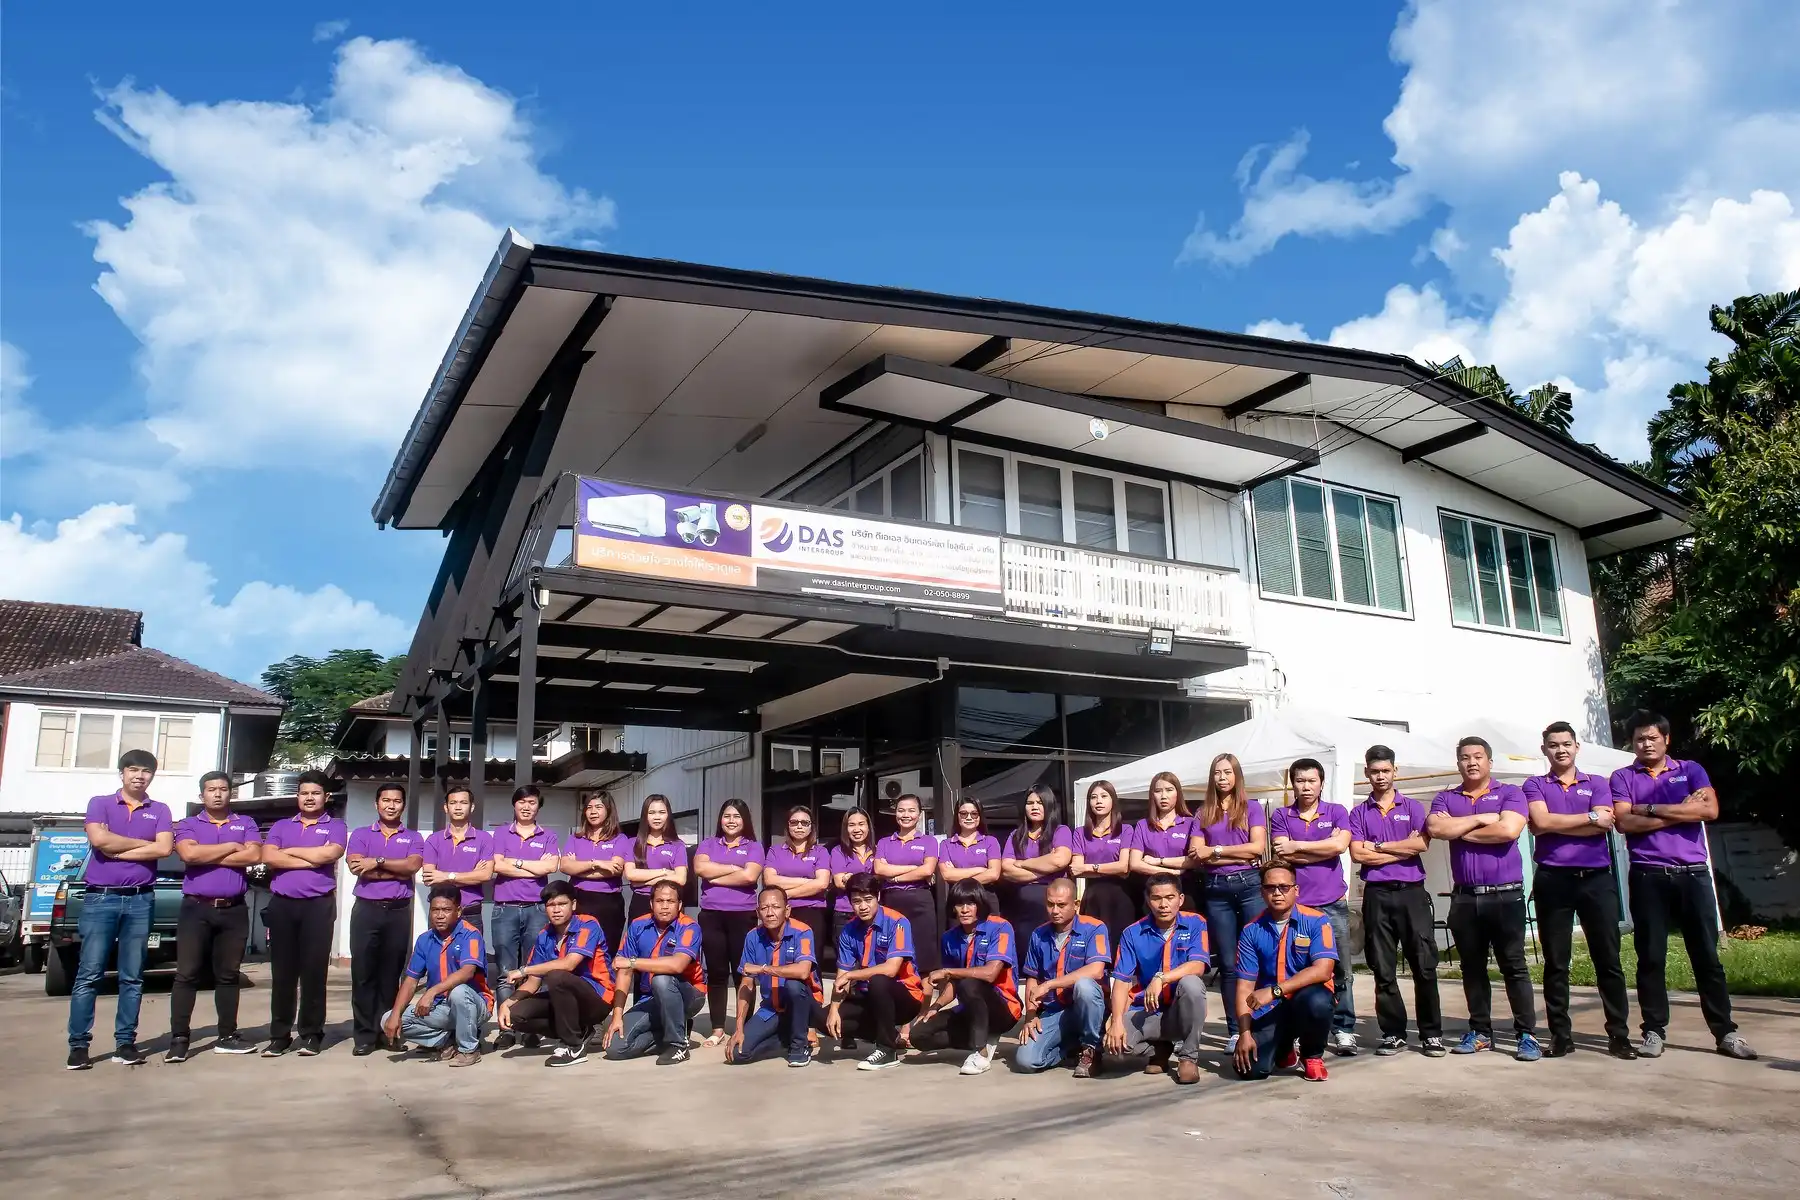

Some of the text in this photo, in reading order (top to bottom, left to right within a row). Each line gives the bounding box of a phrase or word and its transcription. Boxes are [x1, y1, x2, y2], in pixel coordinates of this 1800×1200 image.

[799, 525, 844, 548] DAS
[851, 529, 874, 539] บริษัท
[799, 546, 844, 556] INTERGROUP
[811, 577, 901, 594] www.dasintergroup.com
[924, 588, 970, 600] 02-050-8899
